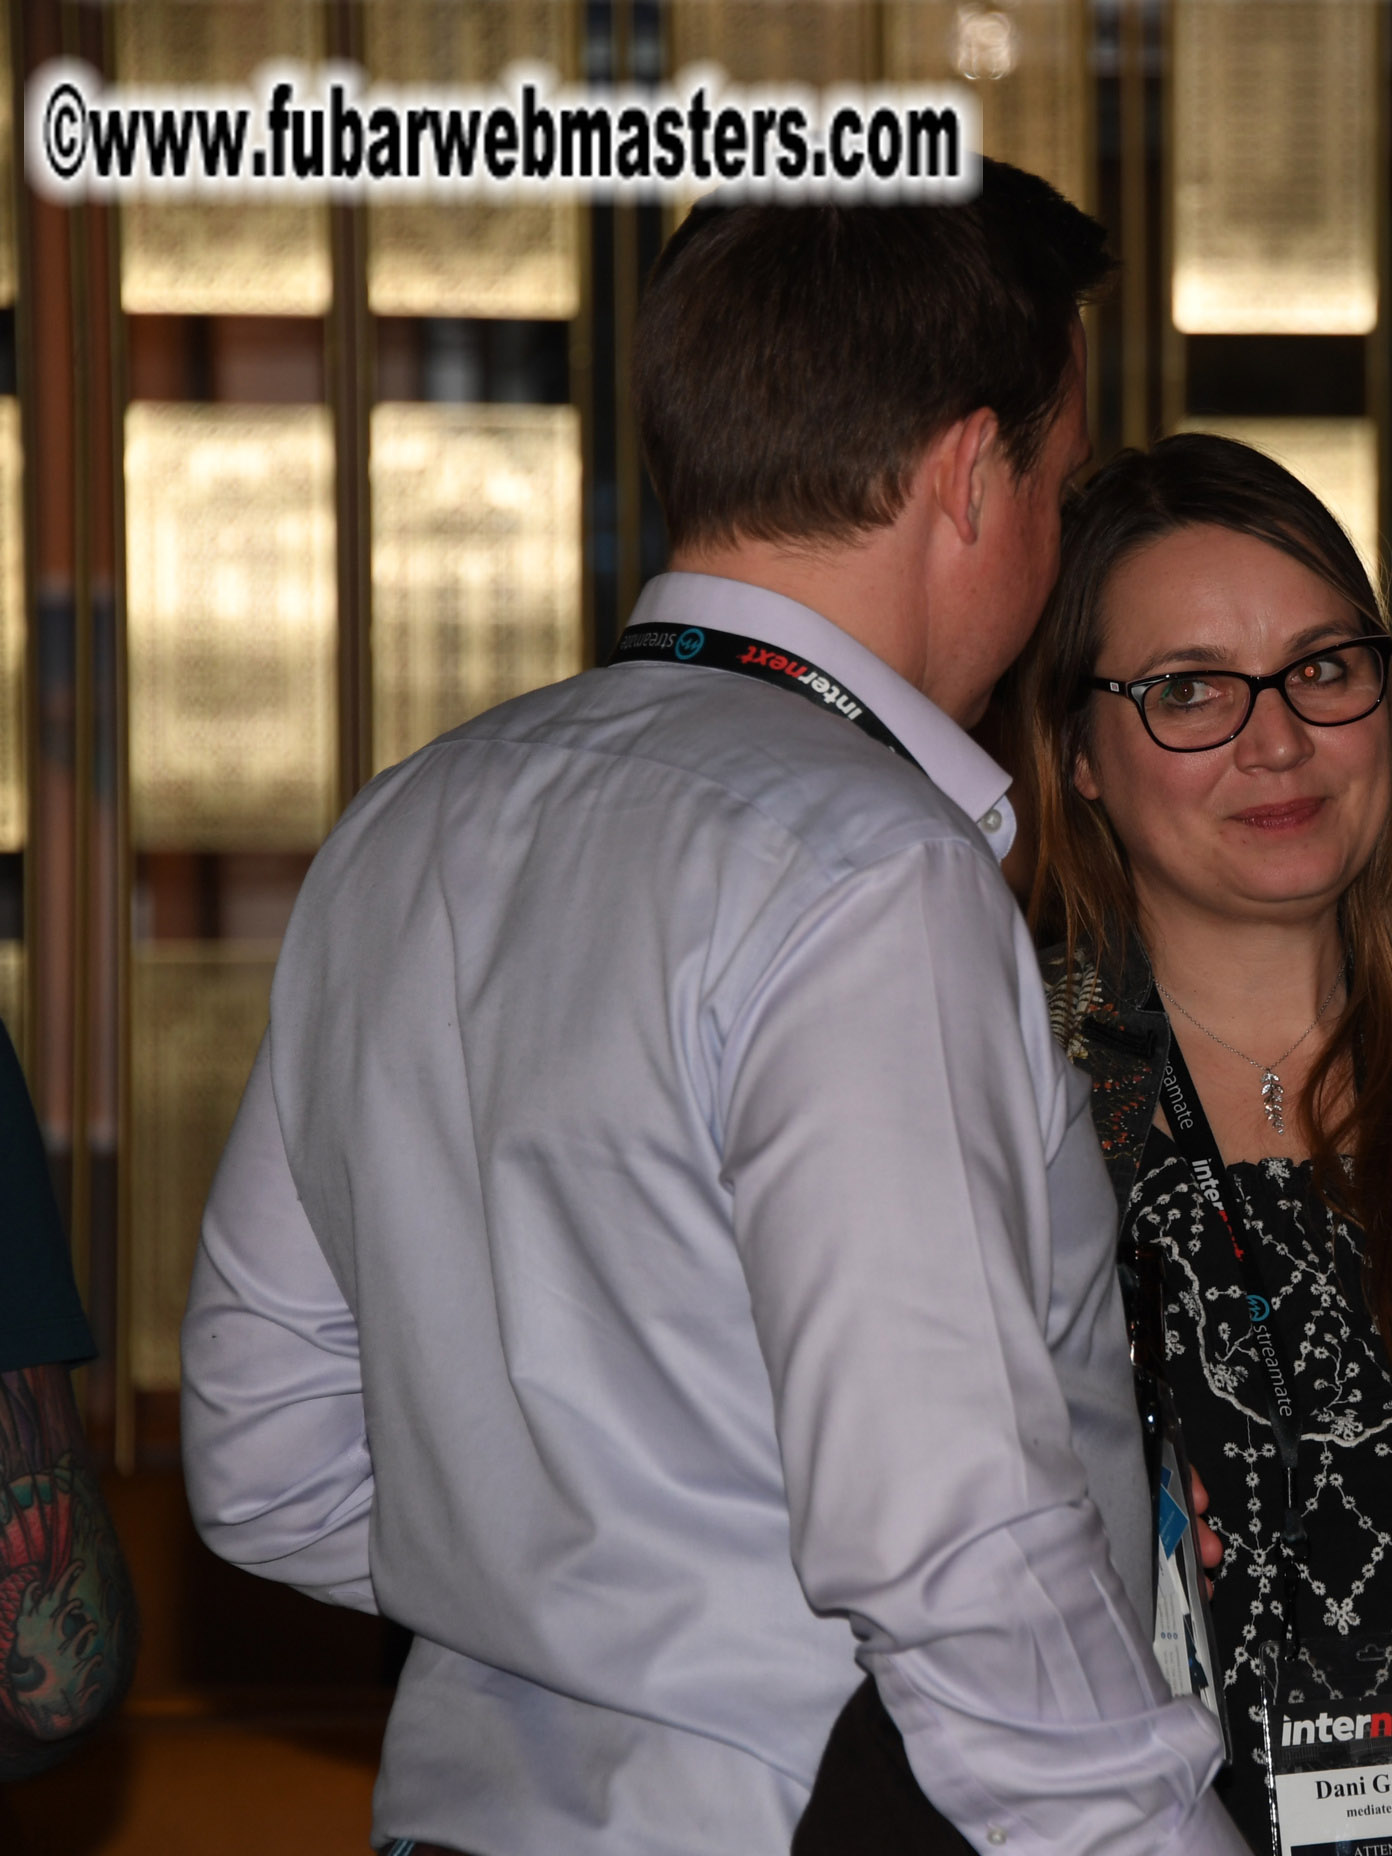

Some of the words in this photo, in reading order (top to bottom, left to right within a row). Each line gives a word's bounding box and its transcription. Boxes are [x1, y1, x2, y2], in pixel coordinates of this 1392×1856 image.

[736, 645, 862, 720] internext
[1164, 1059, 1194, 1130] eamate
[1192, 1158, 1244, 1261] intert
[1253, 1324, 1292, 1417] streamate
[1315, 1776, 1367, 1799] Dani
